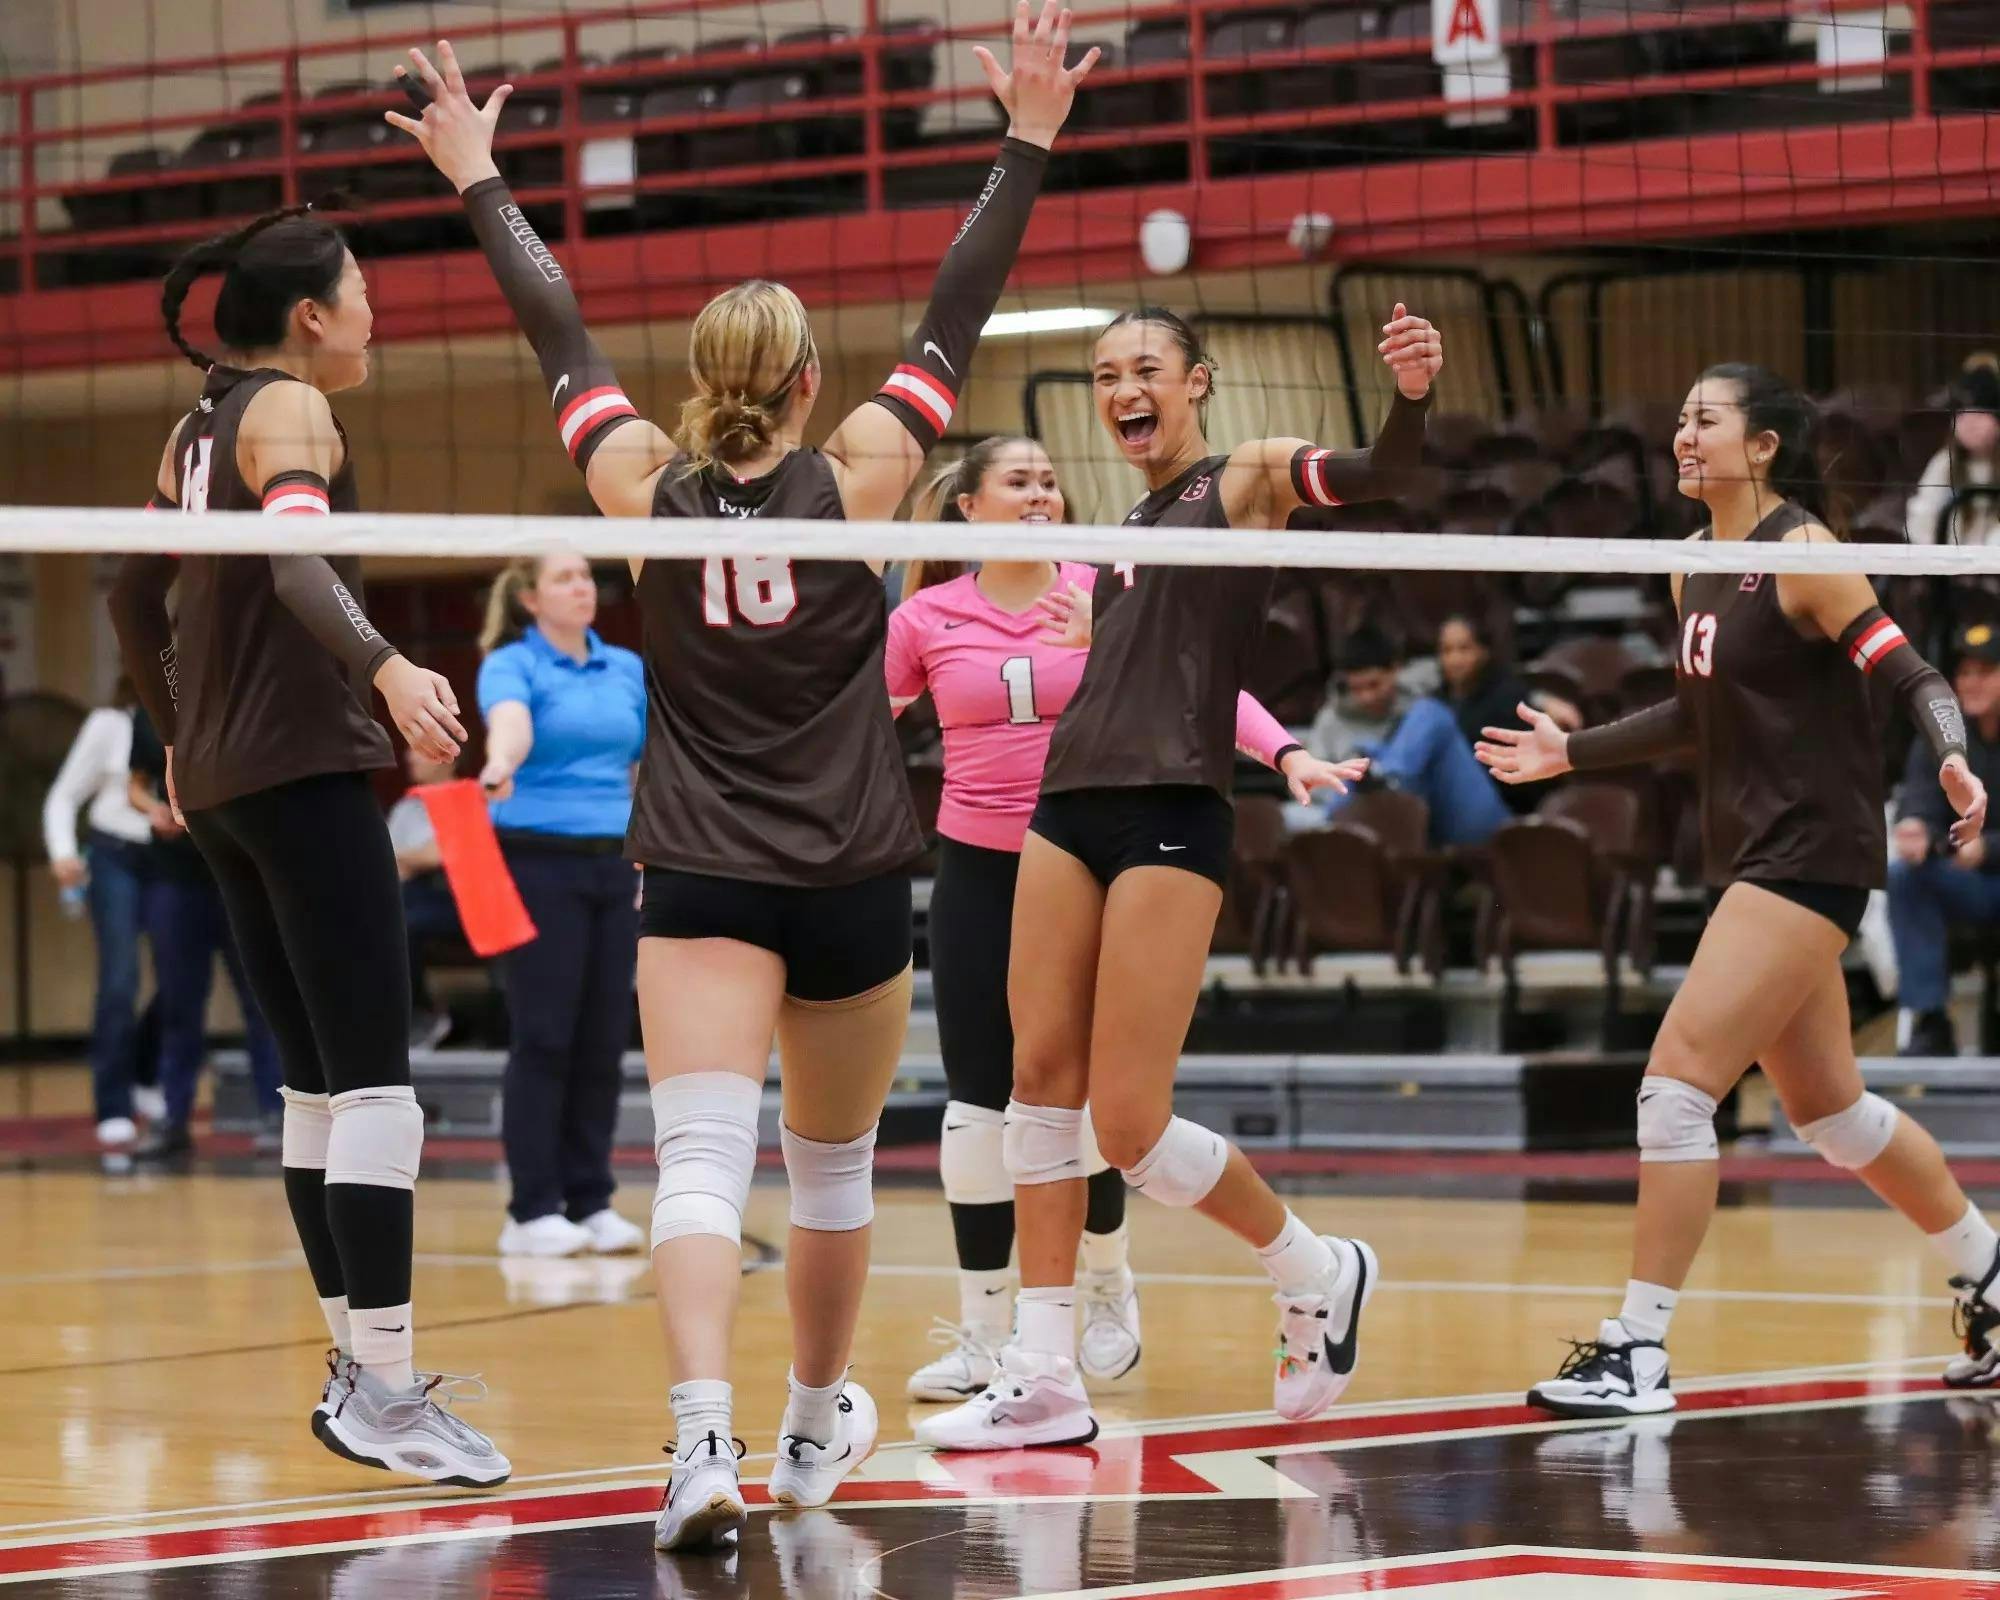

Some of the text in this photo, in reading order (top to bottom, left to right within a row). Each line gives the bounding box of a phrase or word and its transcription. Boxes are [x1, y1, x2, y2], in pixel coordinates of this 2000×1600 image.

[1446, 0, 1485, 46] A
[700, 556, 800, 628] 18
[1681, 611, 1718, 678] 13
[1000, 656, 1042, 724] 1
